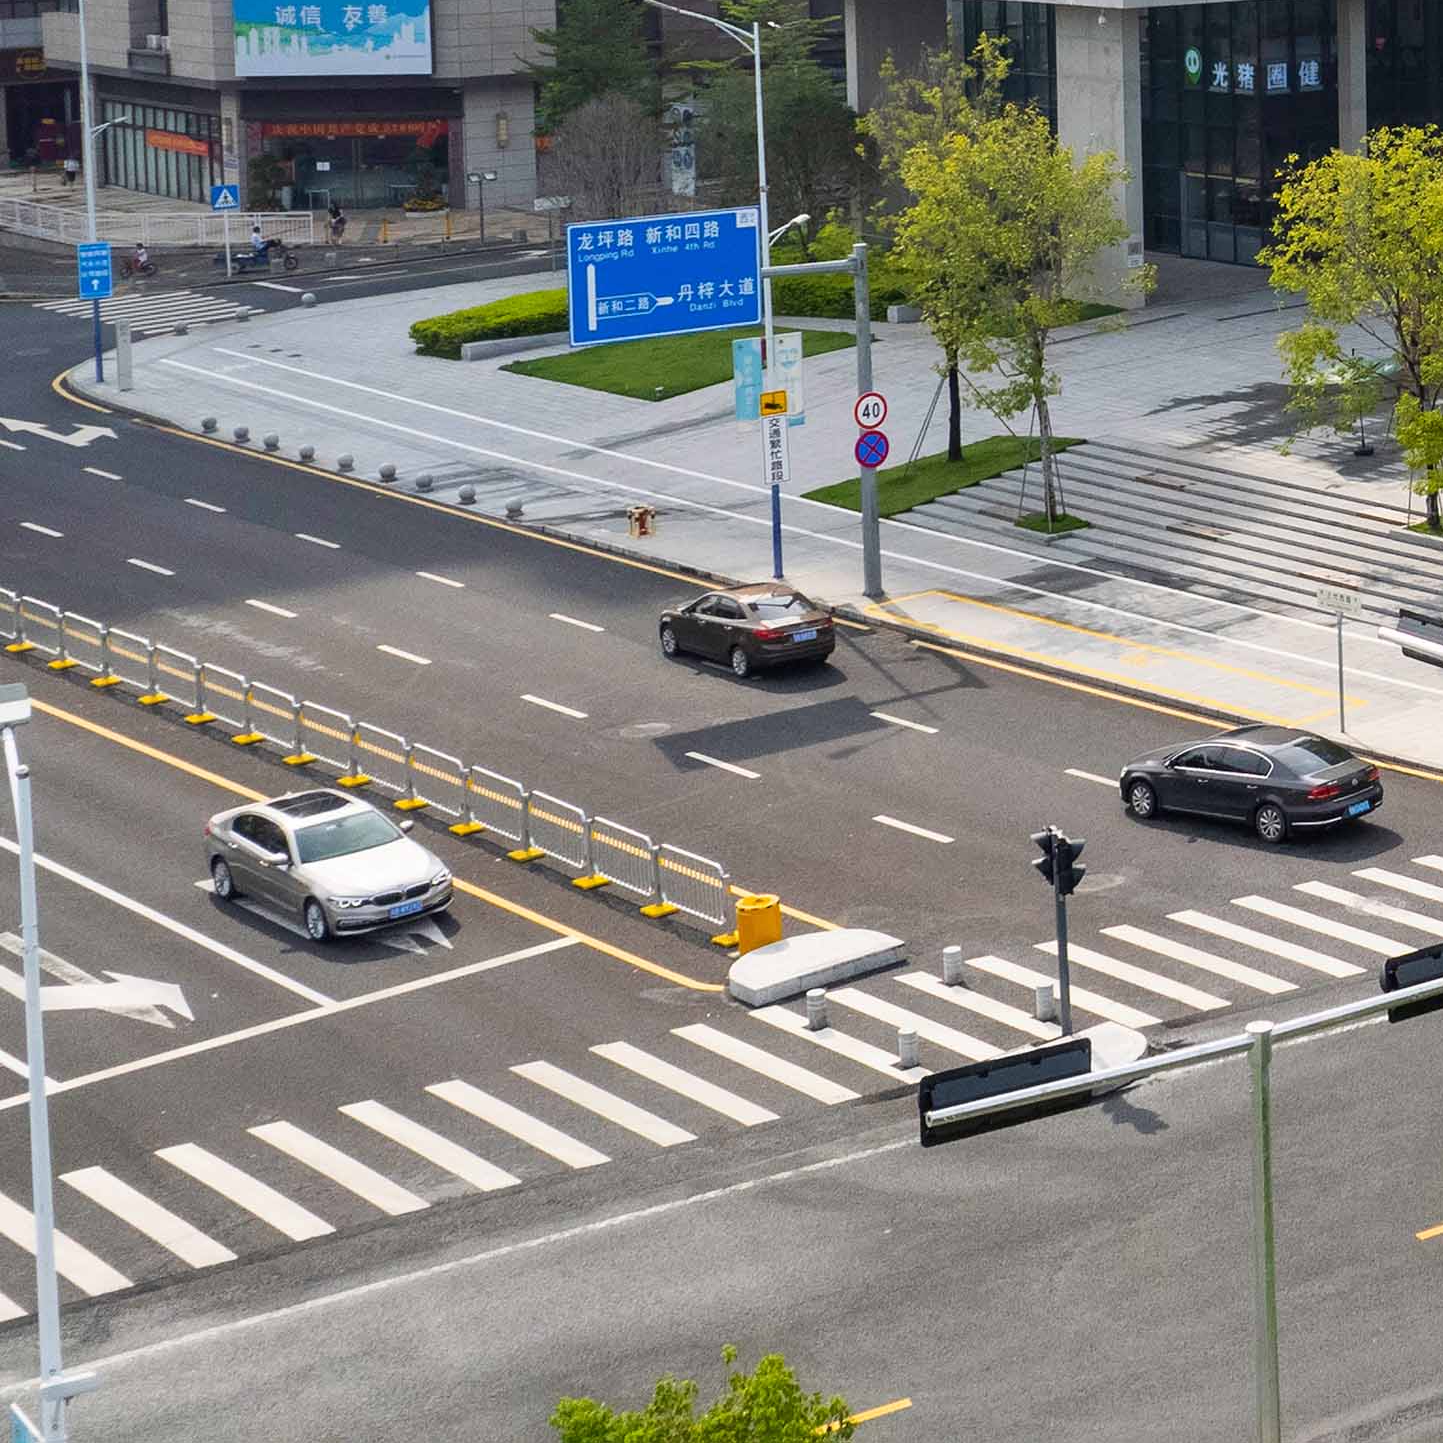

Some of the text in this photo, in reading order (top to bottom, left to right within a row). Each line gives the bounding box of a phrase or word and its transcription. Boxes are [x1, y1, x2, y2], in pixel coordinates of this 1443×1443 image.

[275, 4, 389, 26] 诚信 友善
[577, 220, 720, 251] 龙坪路 新和四路
[578, 240, 716, 263] Longping Rd Xinhe 4th Rd
[677, 277, 756, 303] 丹梓大道
[722, 298, 744, 308] Blvd
[862, 402, 881, 419] 40
[768, 417, 784, 482] 交通繁忙路段
